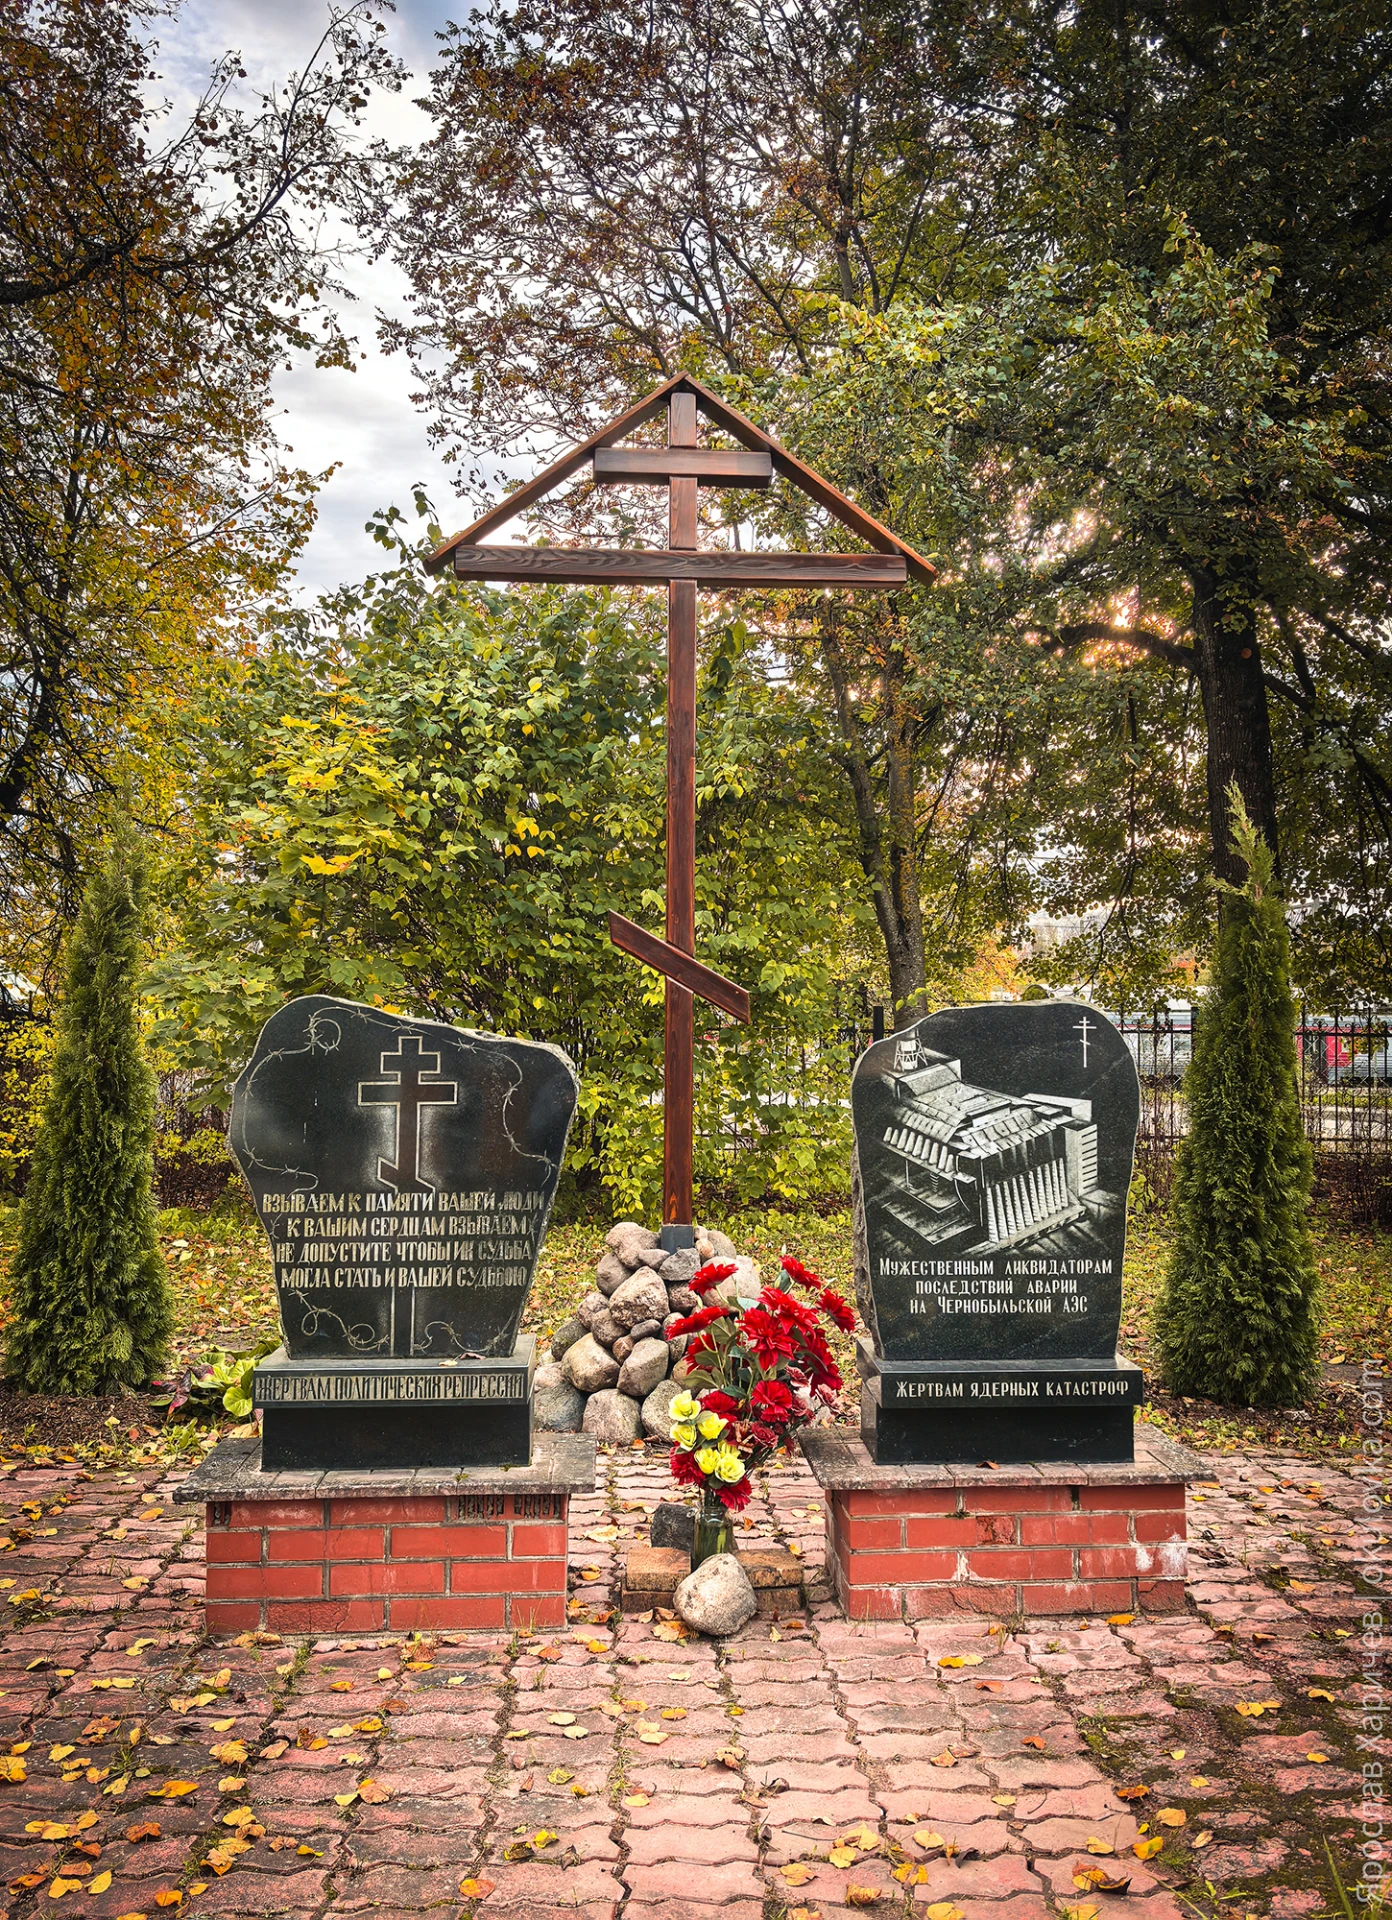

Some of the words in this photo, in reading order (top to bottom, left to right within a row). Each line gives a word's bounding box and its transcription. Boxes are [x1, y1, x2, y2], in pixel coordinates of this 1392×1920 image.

[262, 1193, 344, 1213] ВЗЫВАЕМ
[348, 1193, 362, 1212] К
[365, 1192, 433, 1212] ПАМЯТИ
[438, 1189, 495, 1212] ВАШЕЙ
[287, 1218, 301, 1238] К
[304, 1218, 367, 1238] ВАШИМ
[371, 1217, 445, 1239] СЕРДЦАМ
[448, 1215, 526, 1237] ВЗЫВАЕМ
[276, 1243, 294, 1263] НЕ
[297, 1242, 392, 1265] ДОПУСТИТЕ
[396, 1241, 450, 1262] ЧТОБЫ
[478, 1240, 533, 1262] СУДЬБА
[280, 1268, 330, 1289] МОГЛА
[334, 1267, 382, 1288] СТАТЬ
[385, 1267, 396, 1288] И
[399, 1264, 453, 1287] ВАШЕЙ
[456, 1266, 527, 1290] СУДЬБОЮ
[915, 1278, 1014, 1296] ПОСЛЕДСТВИЙ
[1026, 1280, 1078, 1295] АВАРИИ
[909, 1299, 927, 1314] НА
[257, 1375, 330, 1401] ЖЕРТВАМ
[334, 1374, 441, 1400] ПОЛИТИЧЕСКИХ
[896, 1380, 964, 1398] ЖЕРТВАМ
[970, 1381, 1039, 1399] ЯДЕРНЫХ
[1046, 1380, 1129, 1397] КАТАСТРОФ
